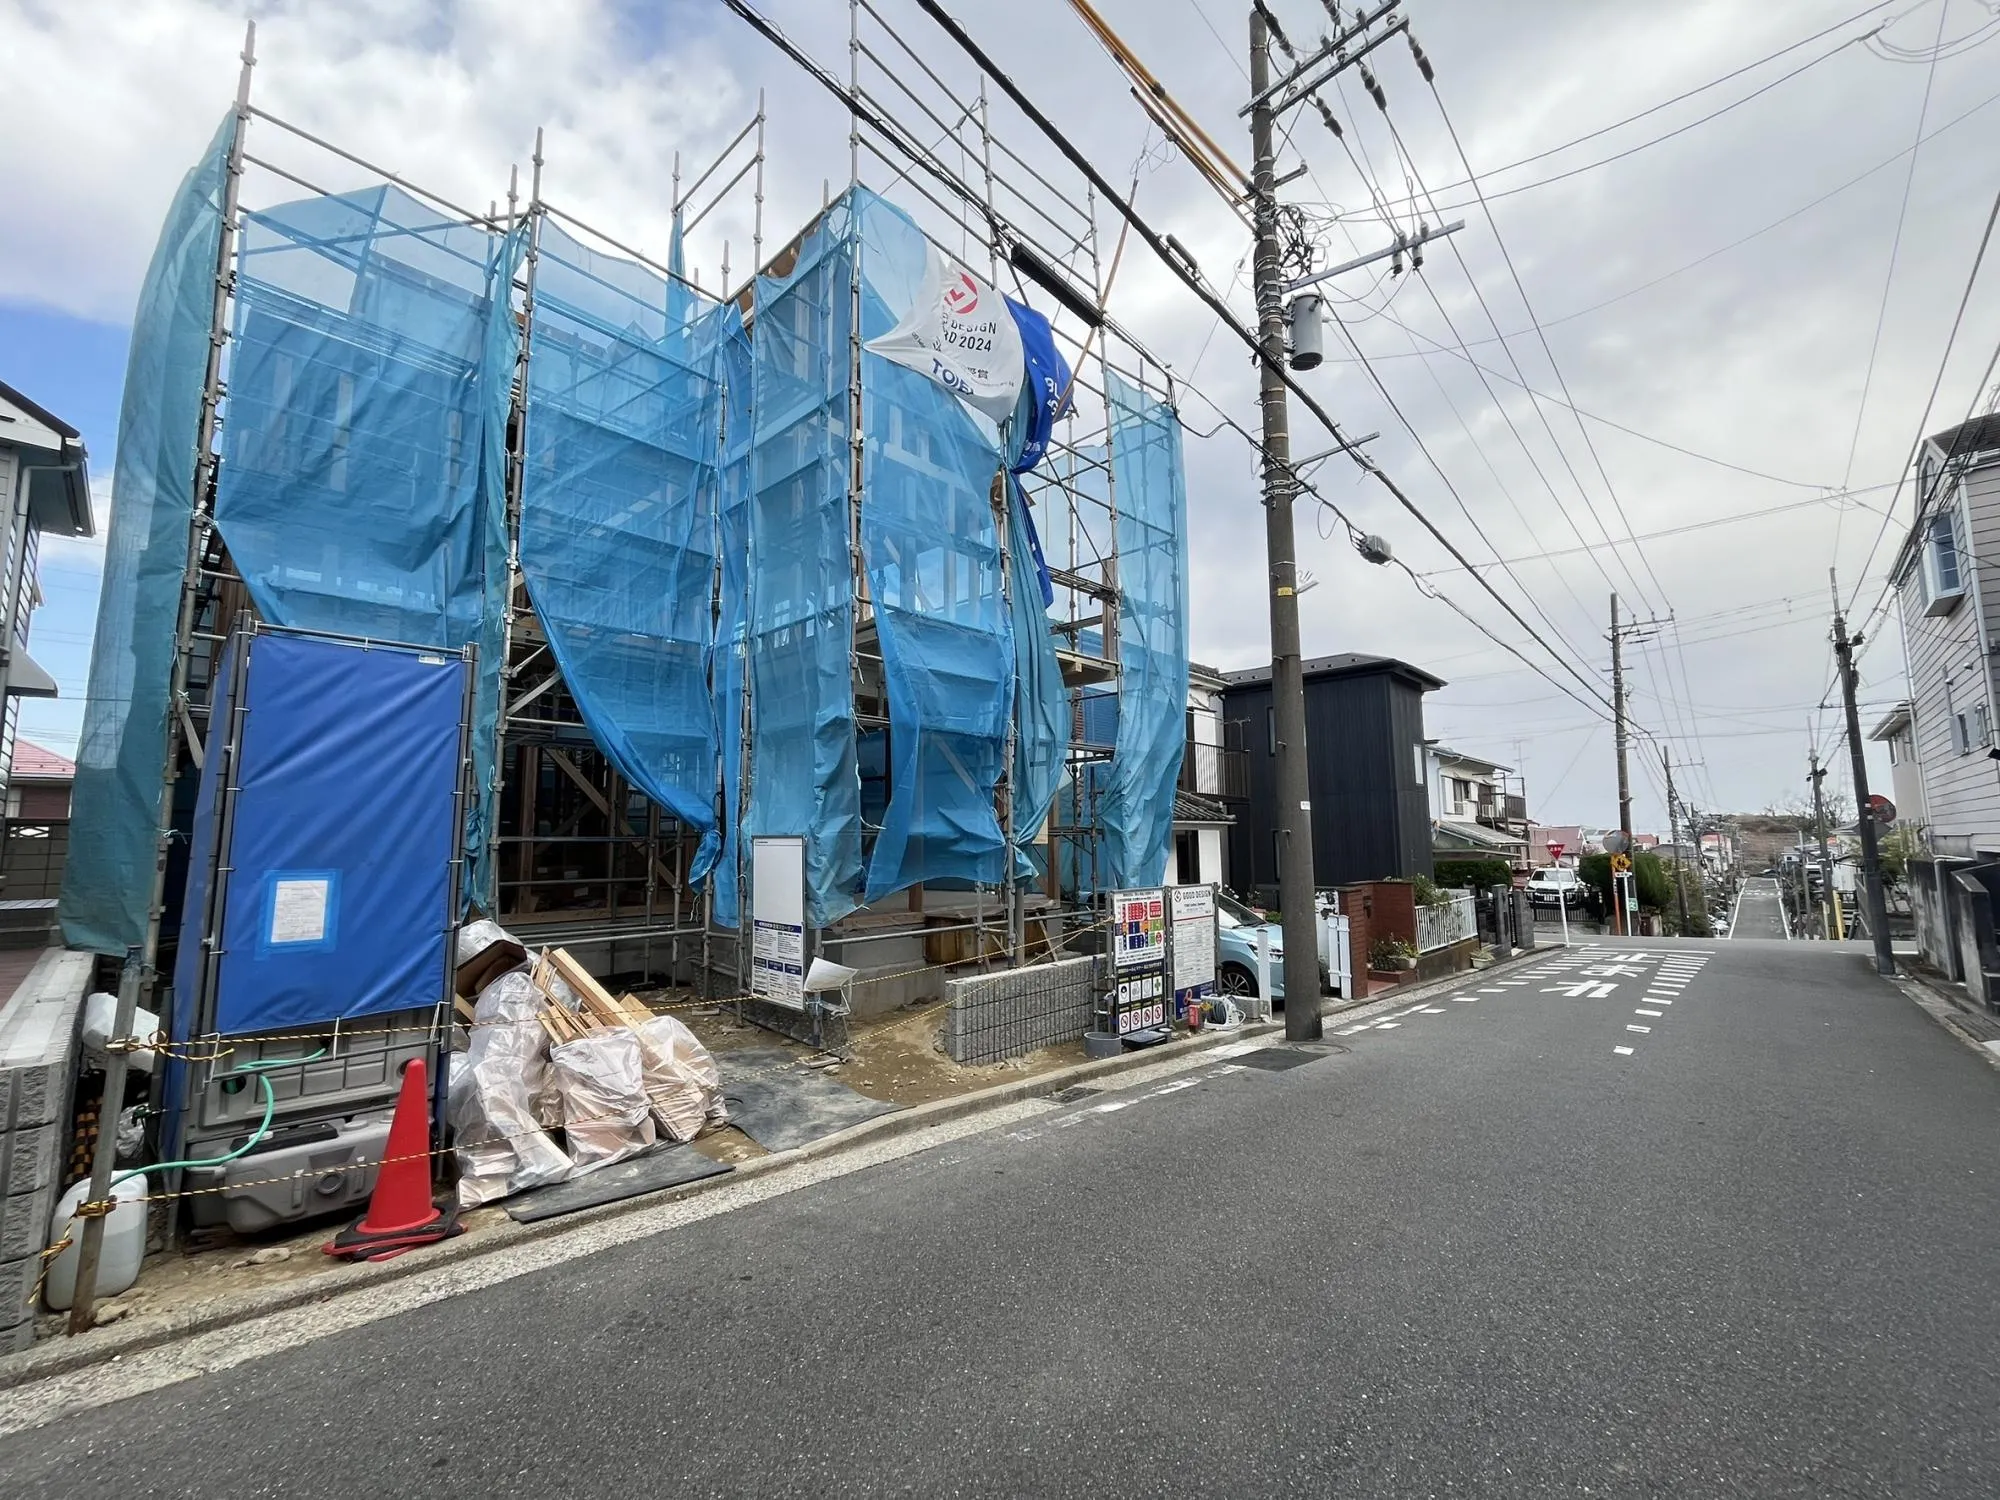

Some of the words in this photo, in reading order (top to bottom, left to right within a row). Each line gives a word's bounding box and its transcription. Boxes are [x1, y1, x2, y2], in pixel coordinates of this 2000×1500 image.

[958, 335, 992, 353] 2024
[1539, 953, 1666, 998] 止まれ
